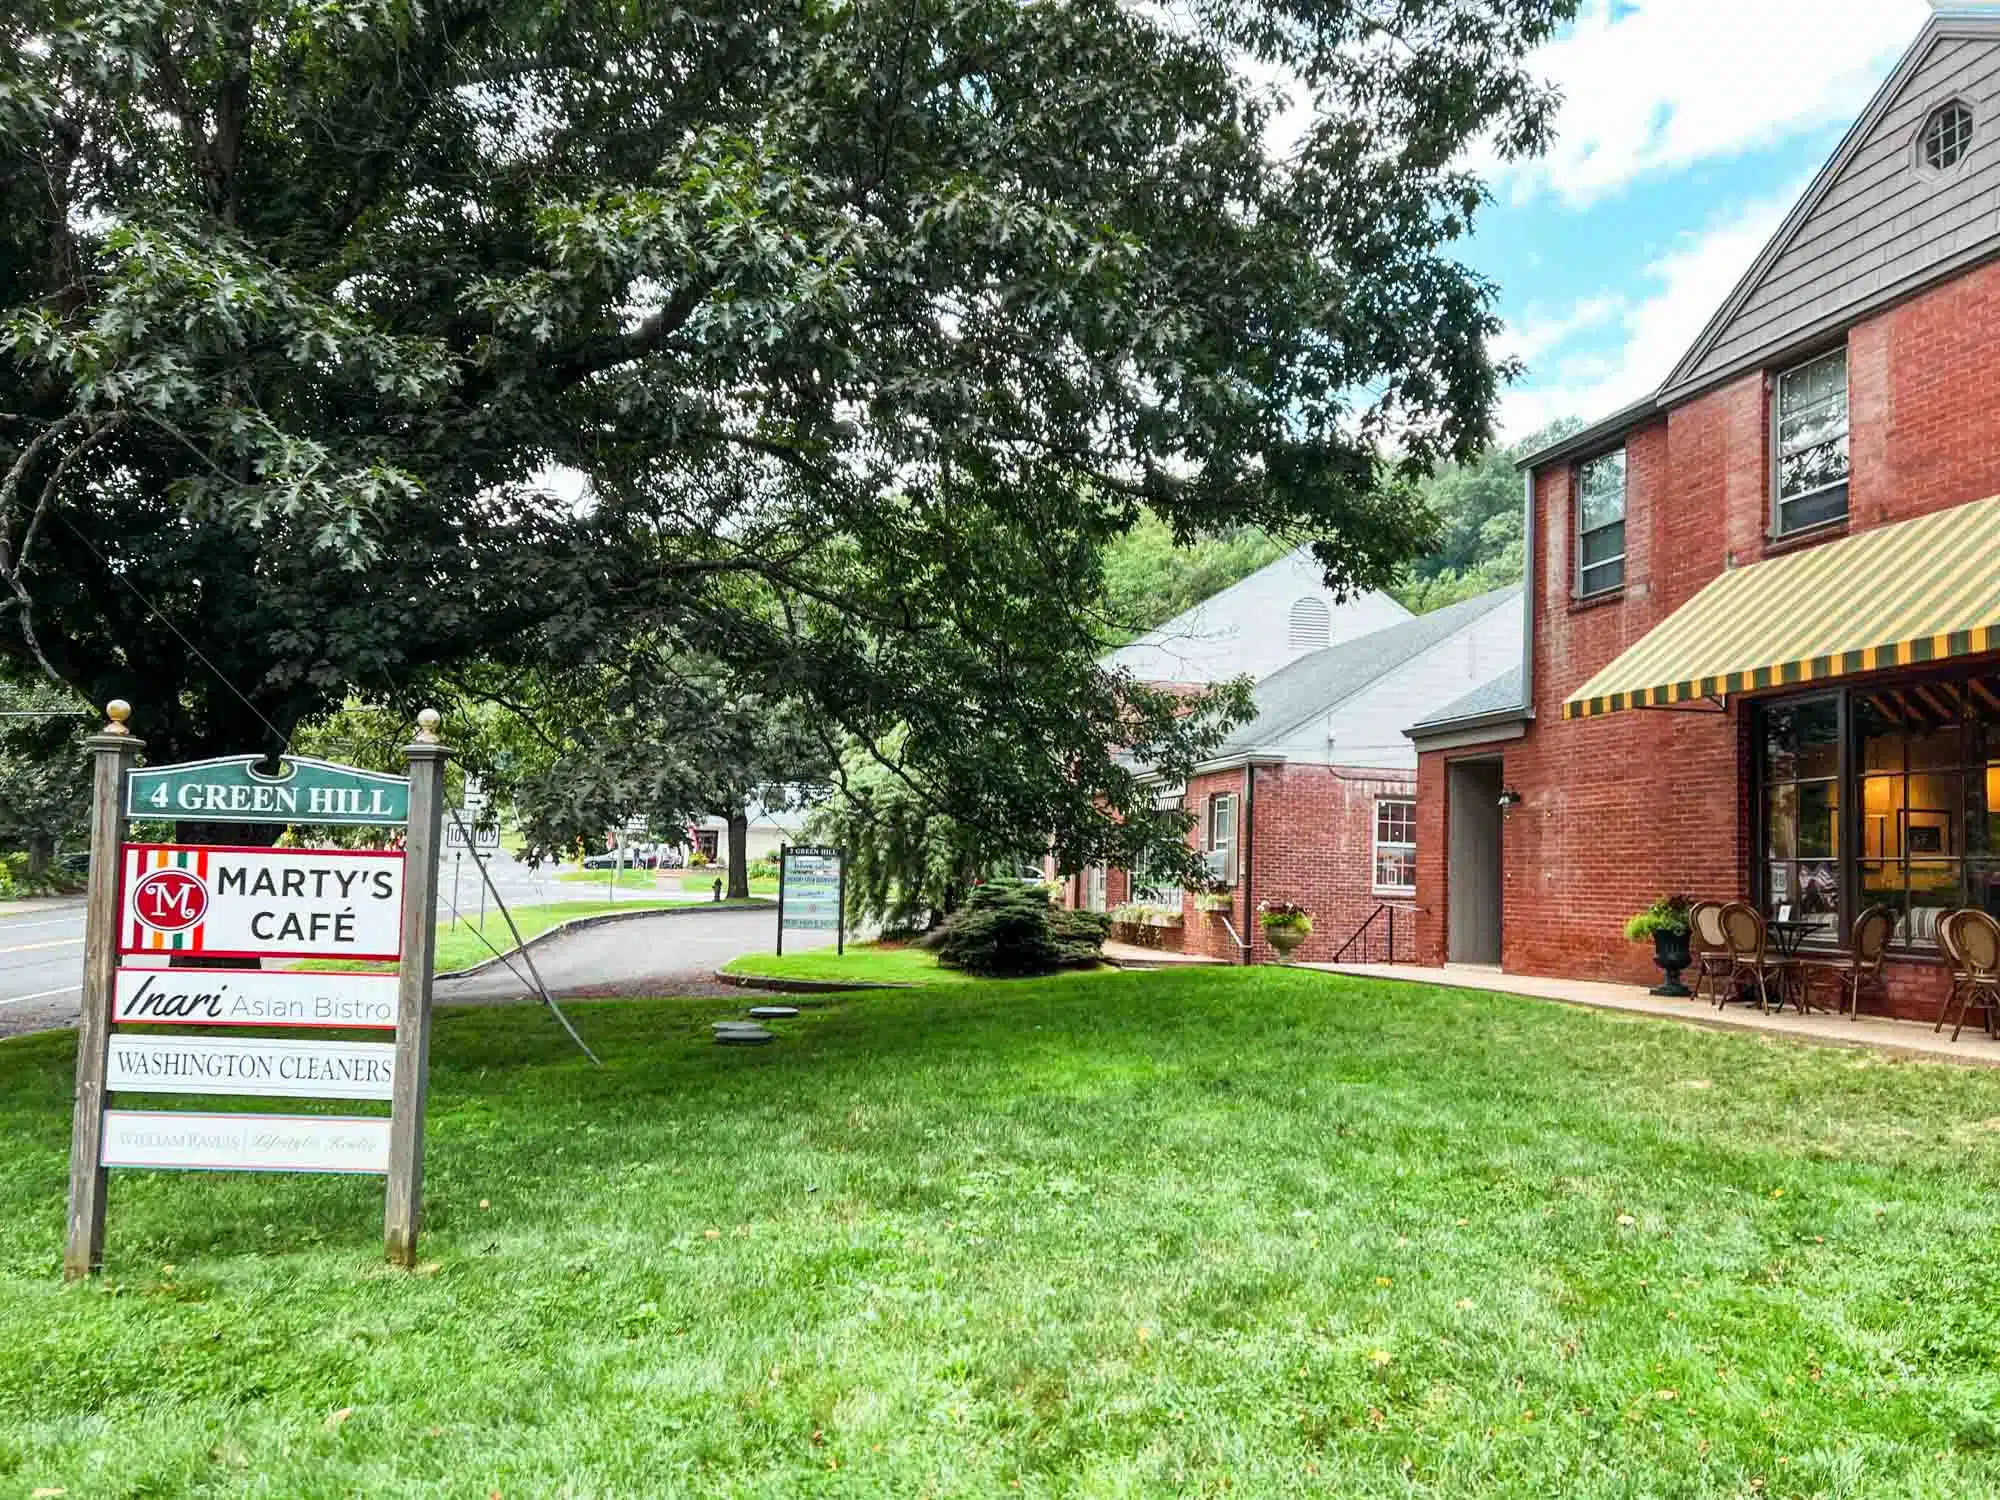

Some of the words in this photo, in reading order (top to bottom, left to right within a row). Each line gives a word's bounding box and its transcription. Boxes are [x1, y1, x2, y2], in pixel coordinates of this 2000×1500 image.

[151, 783, 169, 808] 4
[178, 784, 299, 812] GREEN
[308, 788, 393, 815] HILL
[217, 866, 393, 899] MARTY'S
[145, 882, 197, 920] M
[251, 907, 356, 942] CAFÉ
[123, 975, 228, 1018] Inari
[231, 995, 304, 1018] Asian
[315, 996, 391, 1020] Bistro
[118, 1051, 273, 1080] WASHINGTON
[279, 1055, 392, 1082] CLEANERS
